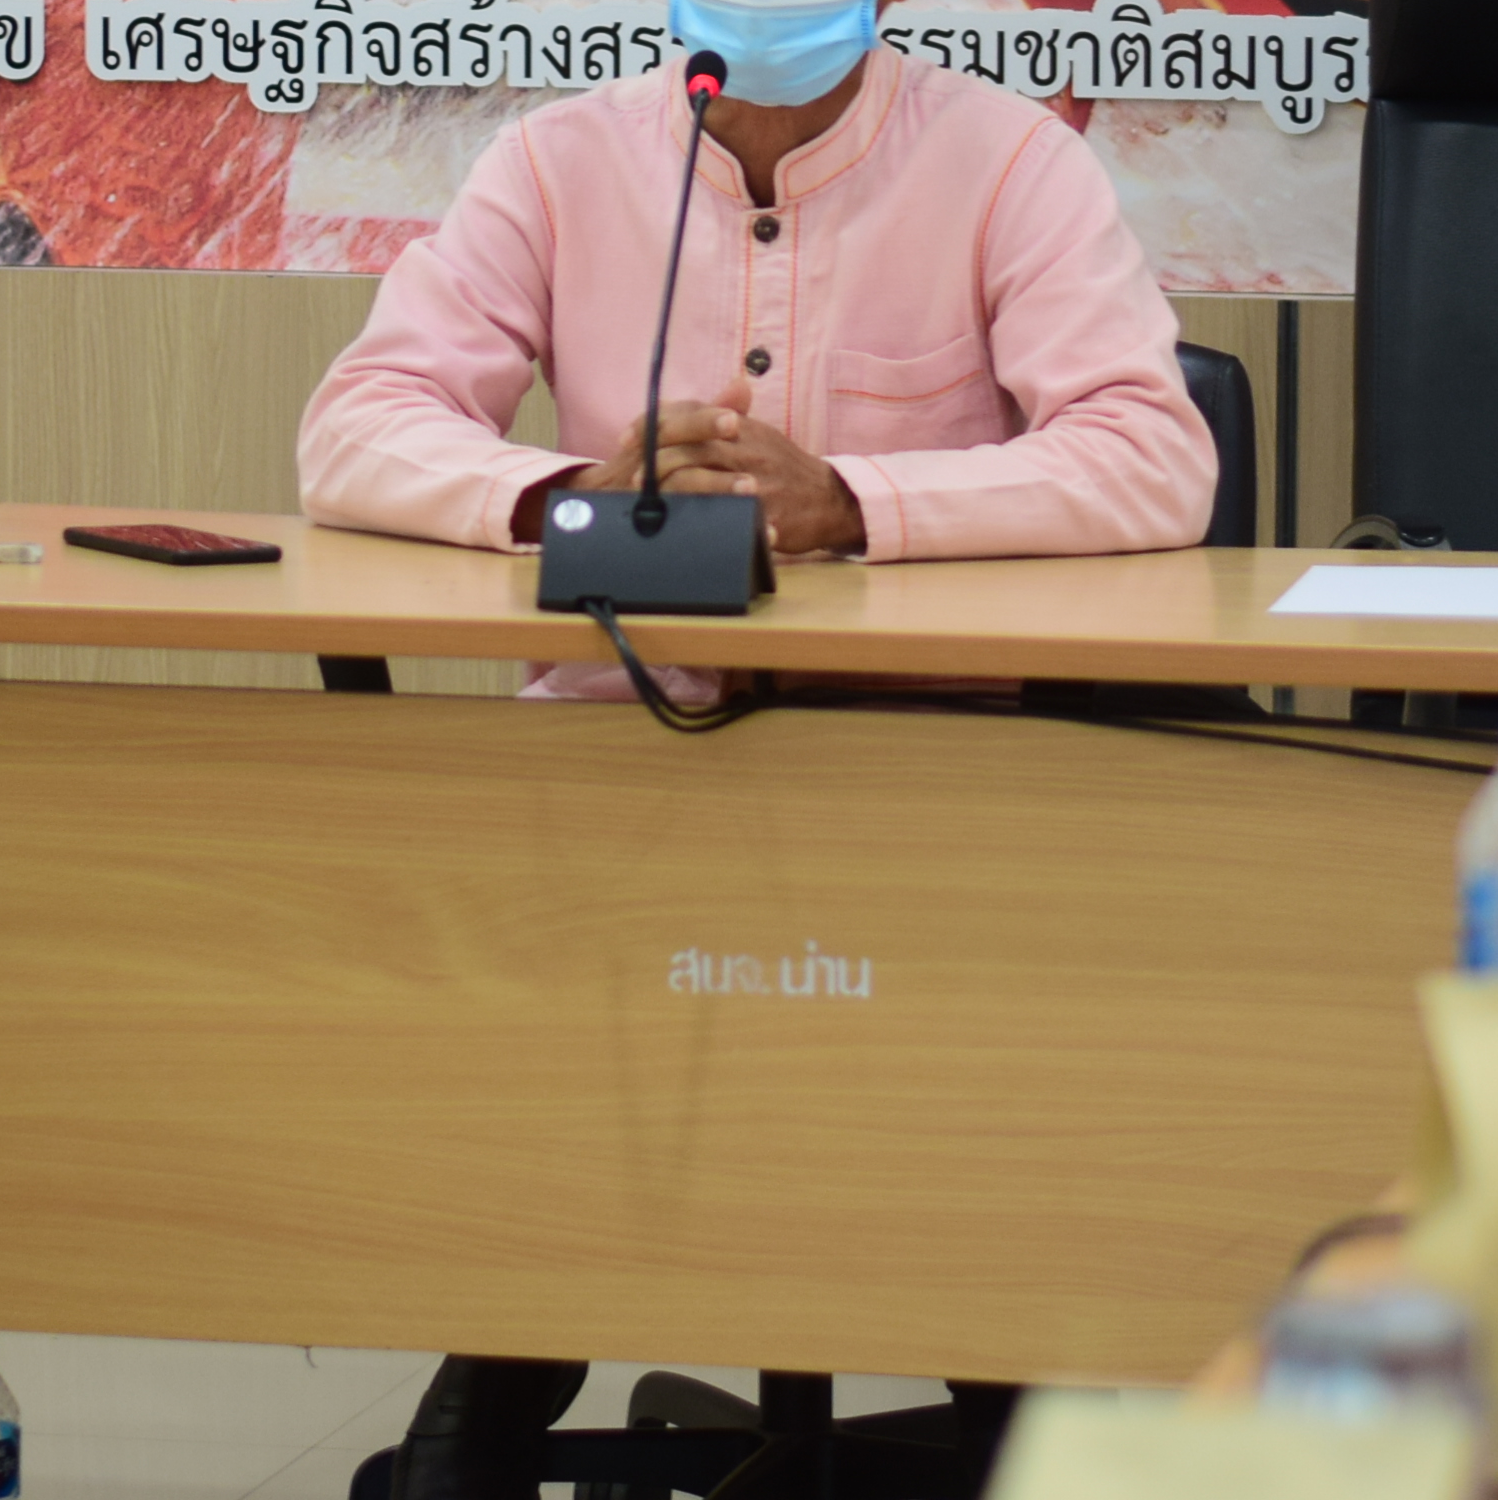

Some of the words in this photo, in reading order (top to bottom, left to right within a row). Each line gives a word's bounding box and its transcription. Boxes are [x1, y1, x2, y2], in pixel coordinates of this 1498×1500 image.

[879, 2, 1369, 125] รรมชาติสมบูร
